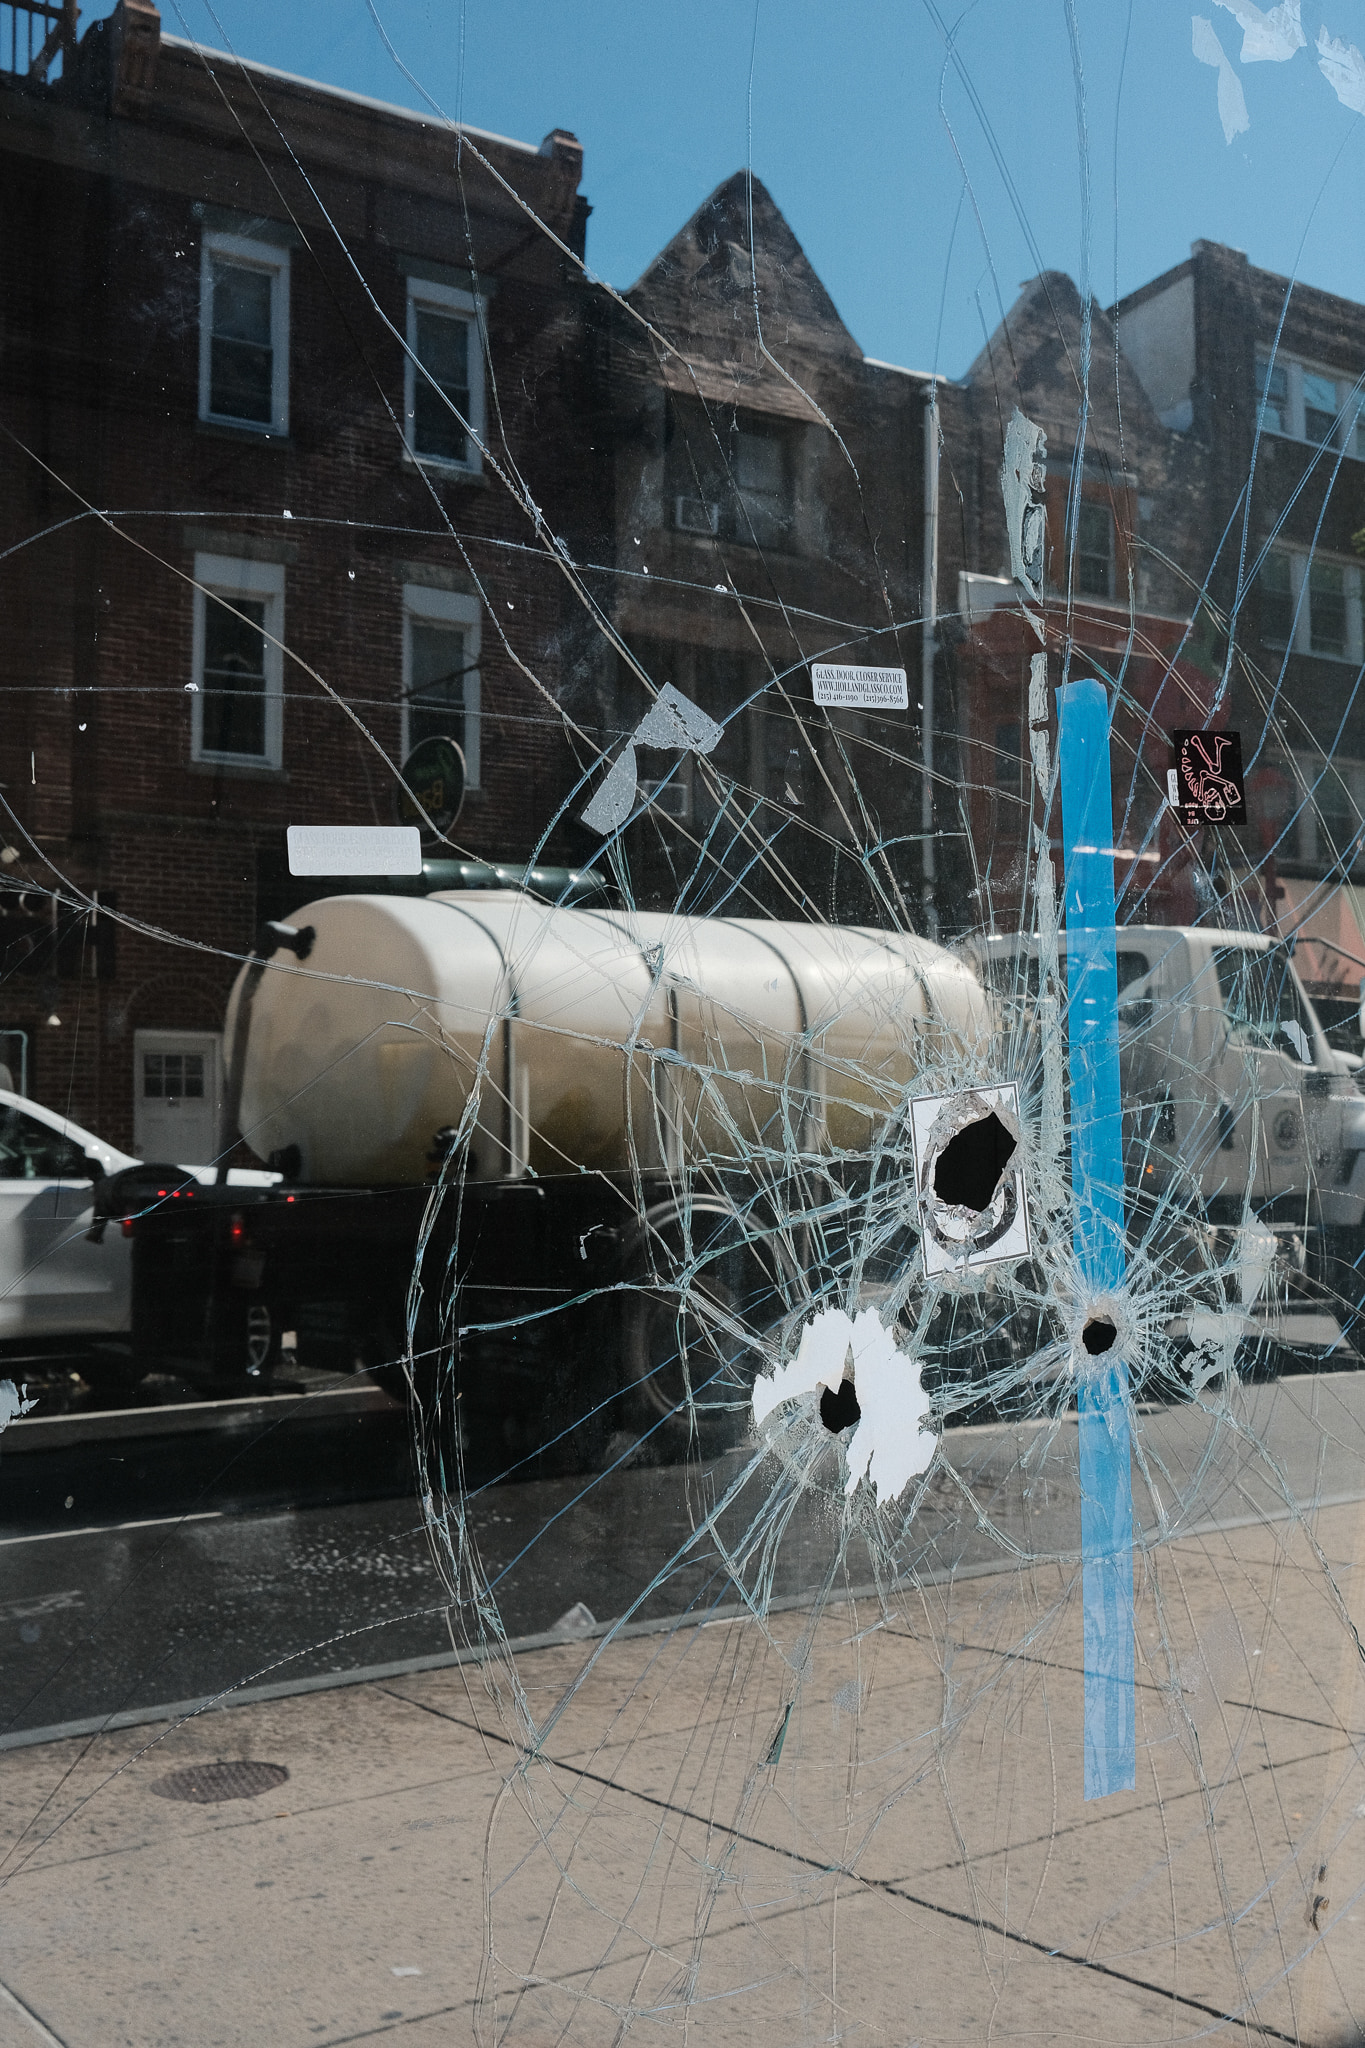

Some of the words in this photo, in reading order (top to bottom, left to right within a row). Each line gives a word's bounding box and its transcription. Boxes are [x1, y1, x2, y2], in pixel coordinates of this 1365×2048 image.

[856, 671, 878, 683] CLOSER
[879, 672, 902, 684] SERVICE
[817, 681, 903, 695] WWW.HOLLANDGLASSCO.COM
